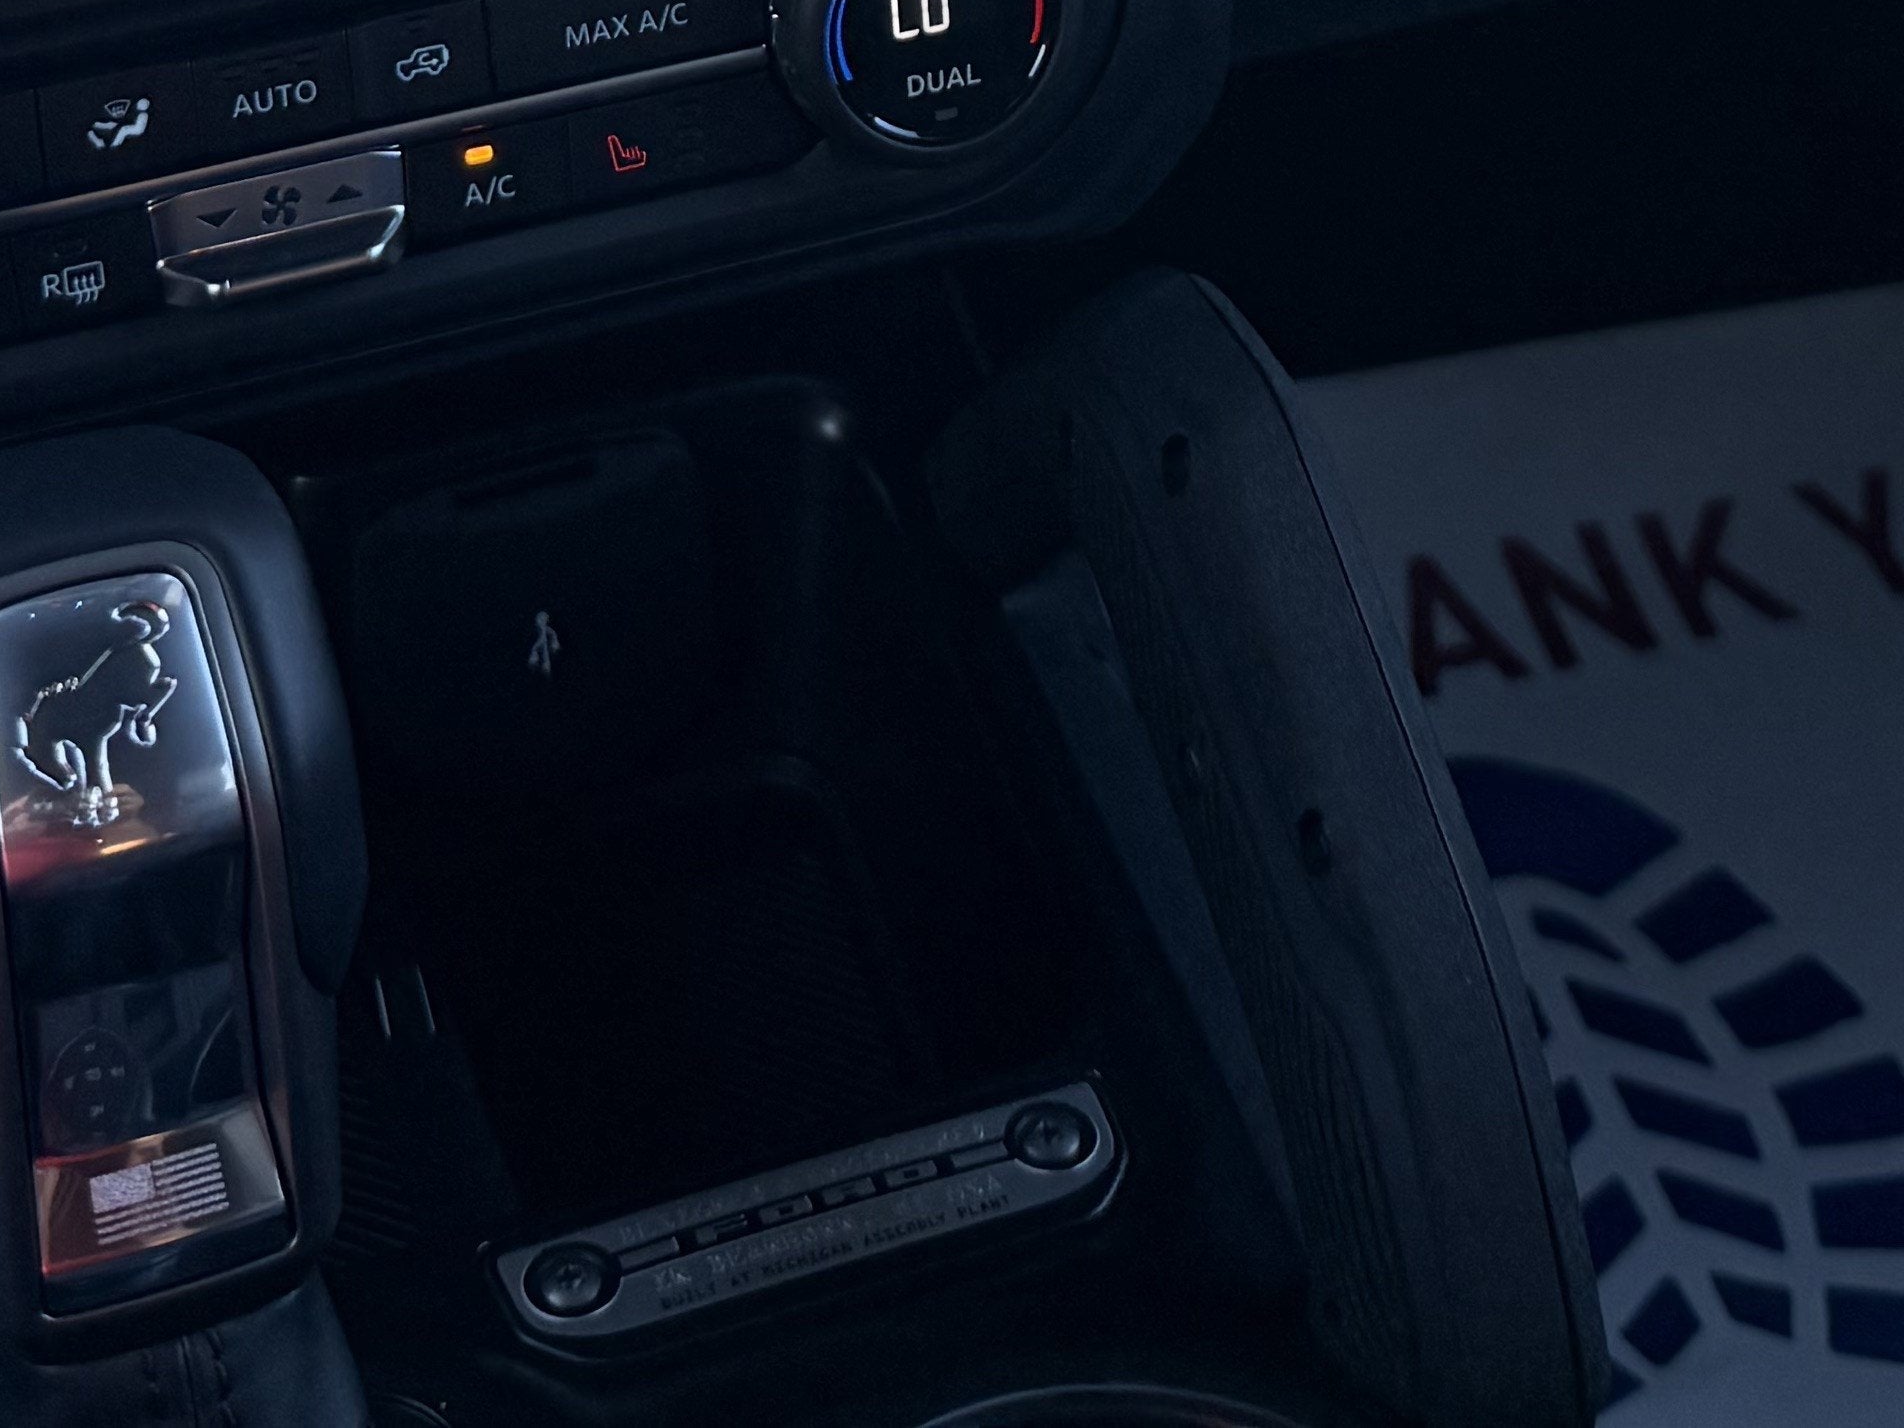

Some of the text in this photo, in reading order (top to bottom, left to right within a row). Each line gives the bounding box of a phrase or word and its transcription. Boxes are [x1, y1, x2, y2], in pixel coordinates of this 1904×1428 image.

[564, 1, 690, 51] MAX A/C
[231, 77, 319, 119] AUTO
[906, 62, 983, 99] DUAL
[463, 172, 516, 210] A/C
[41, 272, 61, 298] R
[1406, 499, 1796, 698] ANK
[696, 1160, 940, 1243] FORD
[760, 1239, 854, 1277] MICHIGAN
[863, 1212, 947, 1246] ASSEMBLY
[956, 1192, 1011, 1220] PLANT
